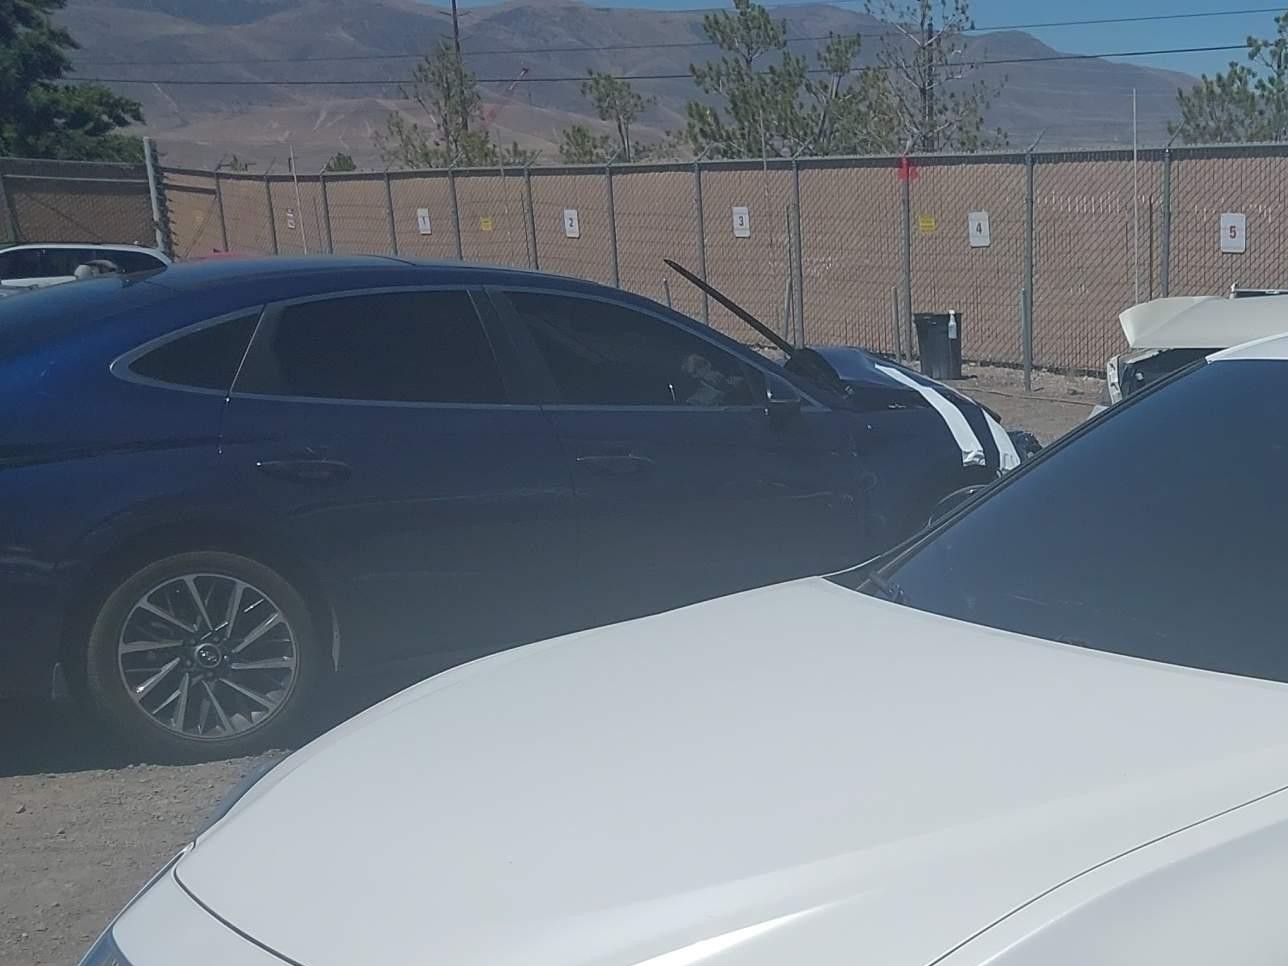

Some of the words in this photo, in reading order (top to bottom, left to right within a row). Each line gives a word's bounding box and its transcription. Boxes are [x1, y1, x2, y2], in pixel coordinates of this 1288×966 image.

[738, 215, 744, 226] 3
[976, 222, 983, 234] 4
[1229, 225, 1237, 239] 5
